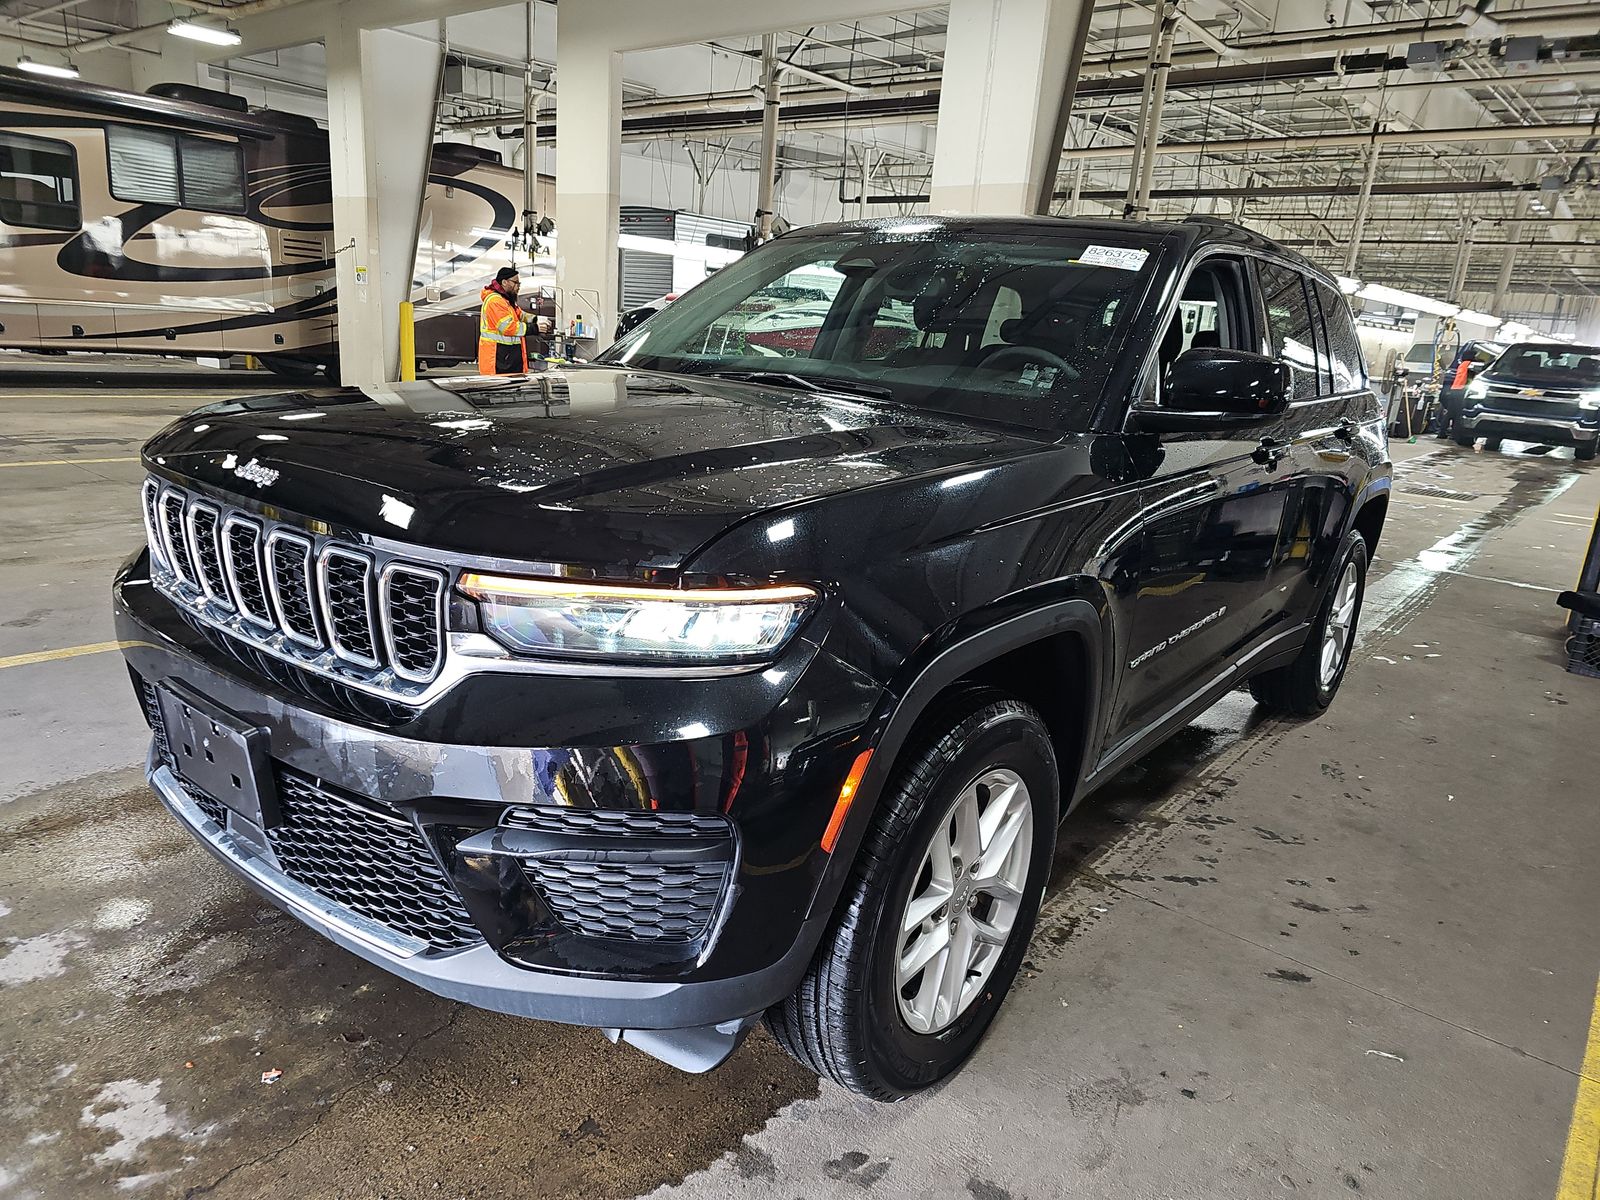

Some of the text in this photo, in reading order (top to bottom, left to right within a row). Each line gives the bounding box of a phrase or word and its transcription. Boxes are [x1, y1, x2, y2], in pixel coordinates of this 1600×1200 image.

[504, 240, 551, 256] SENCA
[1088, 247, 1149, 261] 8263752
[1130, 641, 1167, 669] GRAND
